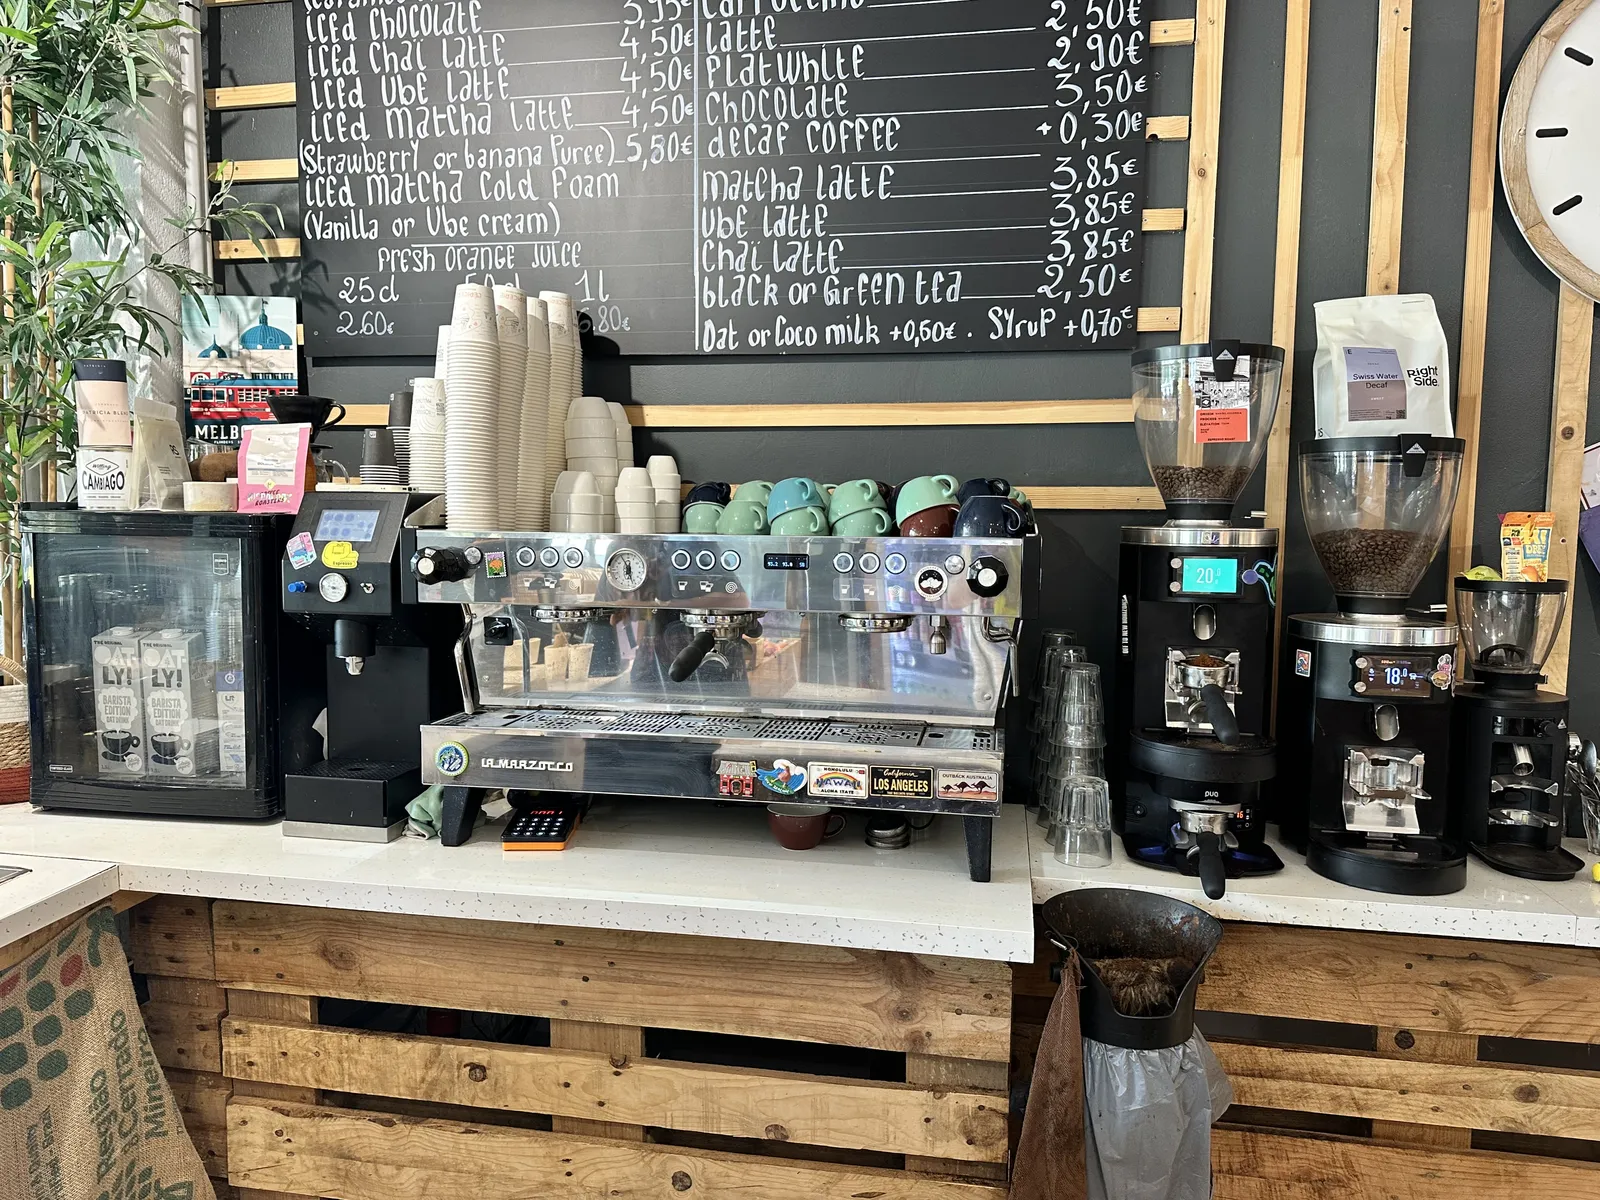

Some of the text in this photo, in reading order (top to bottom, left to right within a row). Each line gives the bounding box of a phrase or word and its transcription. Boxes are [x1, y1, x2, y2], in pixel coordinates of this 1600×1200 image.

[1045, 0, 1141, 38] 2,50€
[619, 23, 694, 64] 4,50€
[1047, 30, 1145, 74] 2,90€
[620, 56, 693, 98] 4,50€
[1055, 69, 1148, 114] 3,50€
[621, 93, 694, 132] 4,50€
[433, 151, 457, 171] or
[463, 138, 543, 166] banana
[1050, 151, 1139, 194] 3,85€
[1049, 191, 1134, 231] 3,85€
[391, 217, 415, 237] or
[1047, 227, 1134, 266] 3,85€
[1037, 263, 1132, 304] 2,50€
[788, 286, 817, 305] or
[748, 329, 771, 347] or
[825, 313, 880, 345] milk
[1352, 373, 1375, 381] Swiss
[1406, 365, 1438, 378] Right
[1365, 381, 1388, 389] Decaf
[194, 424, 244, 440] MELB
[102, 665, 132, 686] LY!
[151, 668, 182, 688] LY!
[103, 695, 132, 706] BARISTA
[104, 706, 131, 716] EDITION
[151, 698, 181, 708] BARISTA
[153, 708, 181, 719] EDITION
[816, 778, 860, 790] HAWAII
[883, 769, 918, 778] California
[873, 778, 929, 792] LOS ANGELES
[108, 1010, 138, 1139] Cerrado
[137, 1026, 168, 1139] Mineiro
